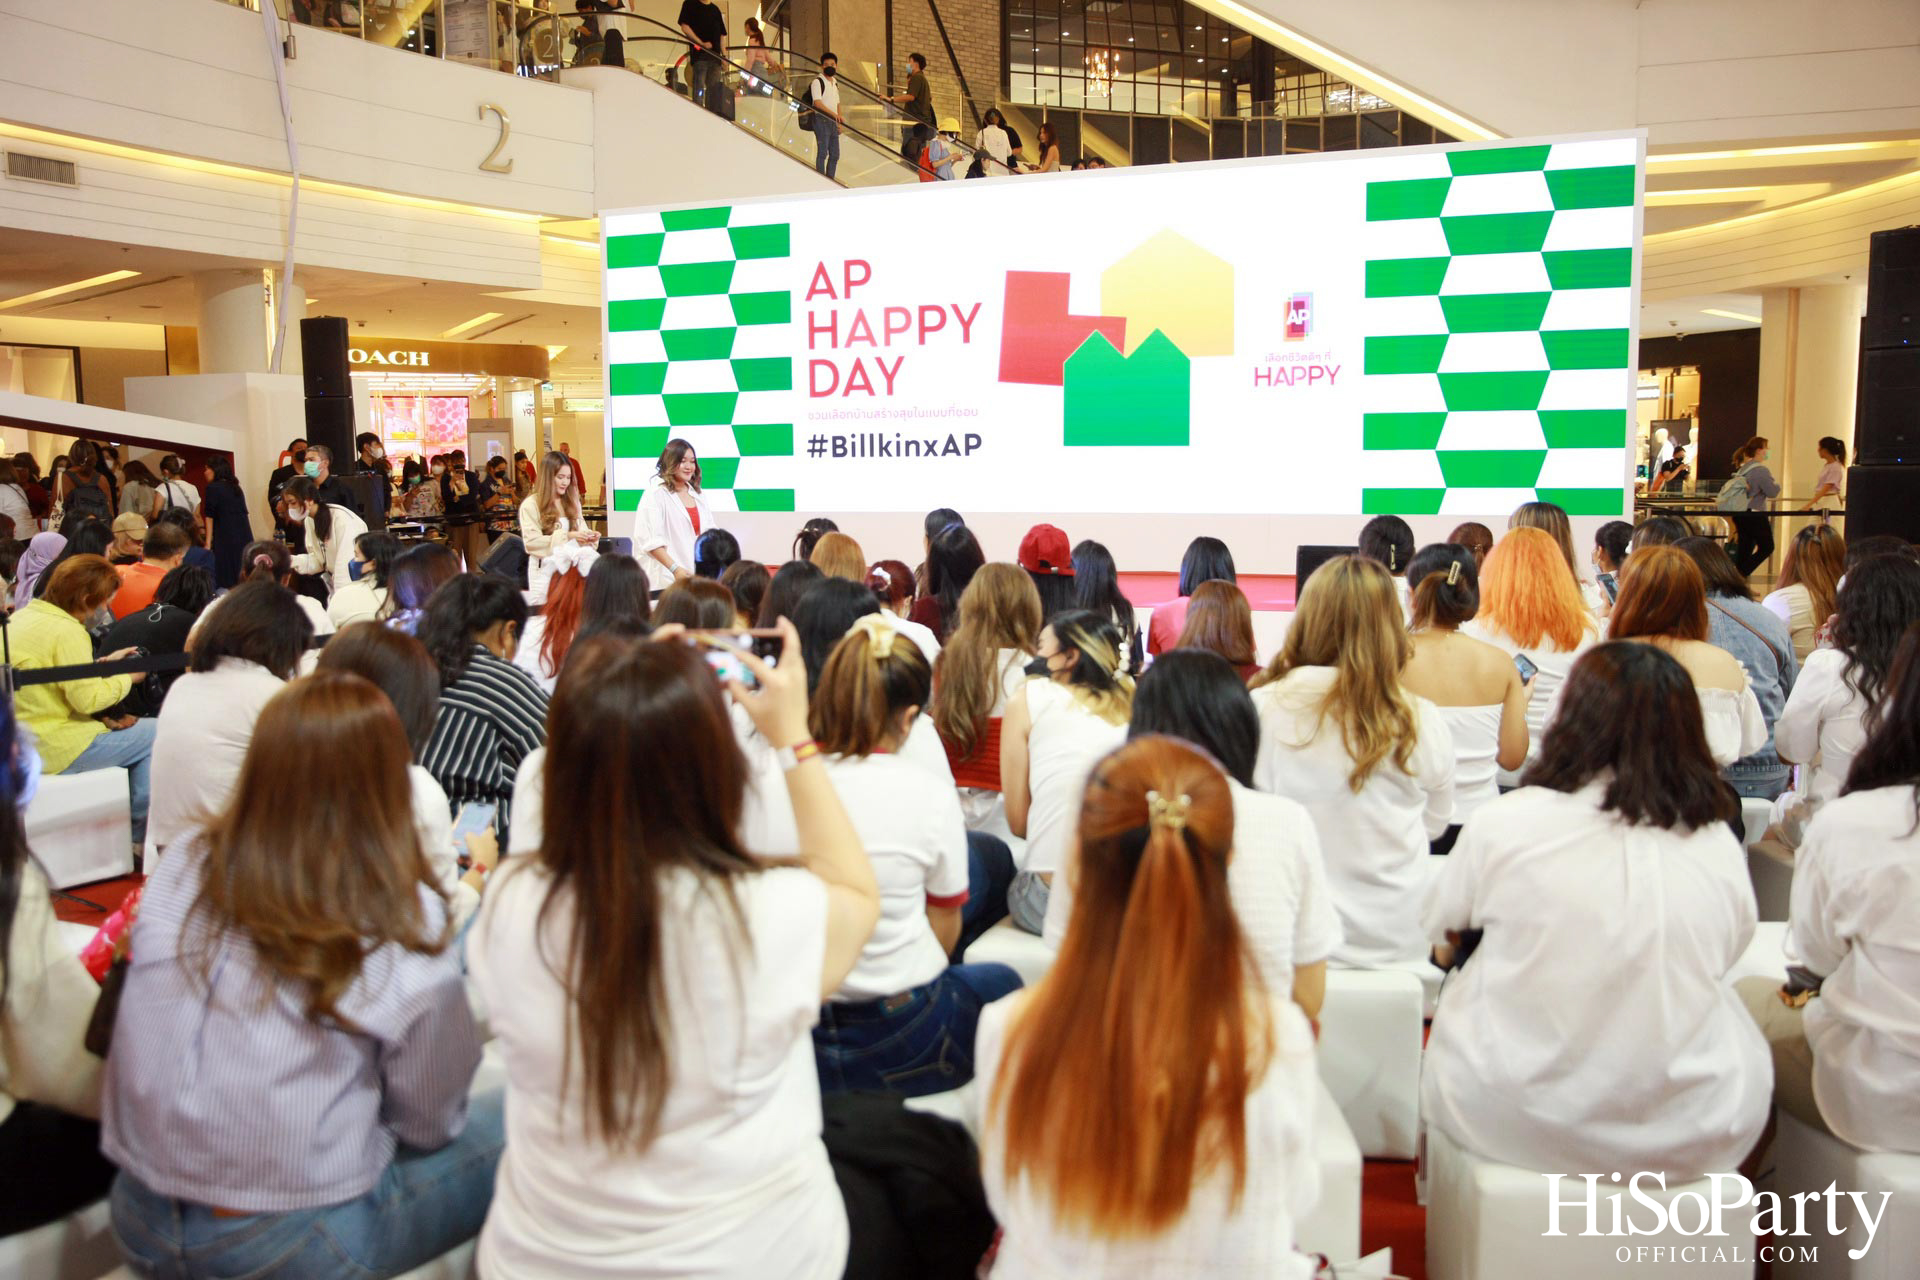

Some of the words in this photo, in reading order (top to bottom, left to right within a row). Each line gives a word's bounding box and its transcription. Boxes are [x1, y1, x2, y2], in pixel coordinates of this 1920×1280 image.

[479, 104, 513, 174] 2
[805, 259, 871, 301] AP
[808, 302, 982, 350] HAPPY
[1286, 309, 1310, 325] AP
[348, 348, 430, 366] OACH
[809, 356, 905, 398] DAY
[1254, 364, 1341, 387] HAPPY
[807, 432, 982, 459] #BillkinxAP
